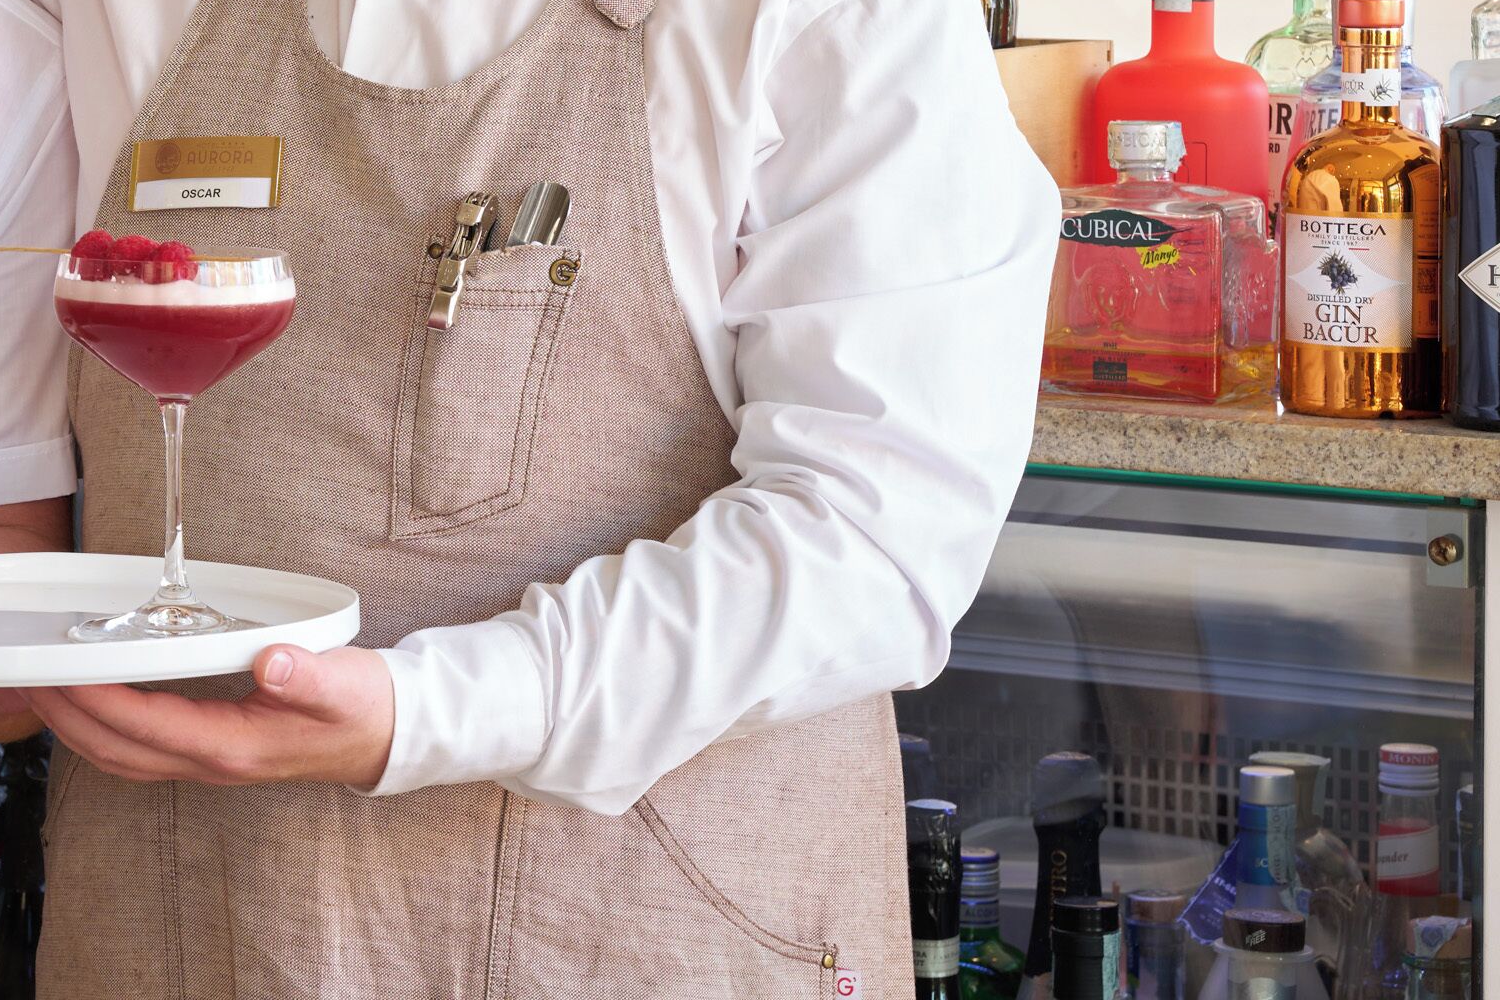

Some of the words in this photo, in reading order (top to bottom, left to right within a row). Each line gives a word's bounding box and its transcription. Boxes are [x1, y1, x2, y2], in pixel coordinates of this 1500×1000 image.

[187, 151, 254, 165] AURORA
[181, 188, 222, 199] OSCAR
[1061, 217, 1161, 242] CUBICAL
[1300, 220, 1387, 236] BOTTEGA
[1307, 294, 1352, 304] DISTILLED
[1355, 296, 1375, 305] DRY
[1315, 303, 1363, 324] GIN
[1303, 321, 1380, 344] BACÛR
[1388, 752, 1435, 765] MONIN
